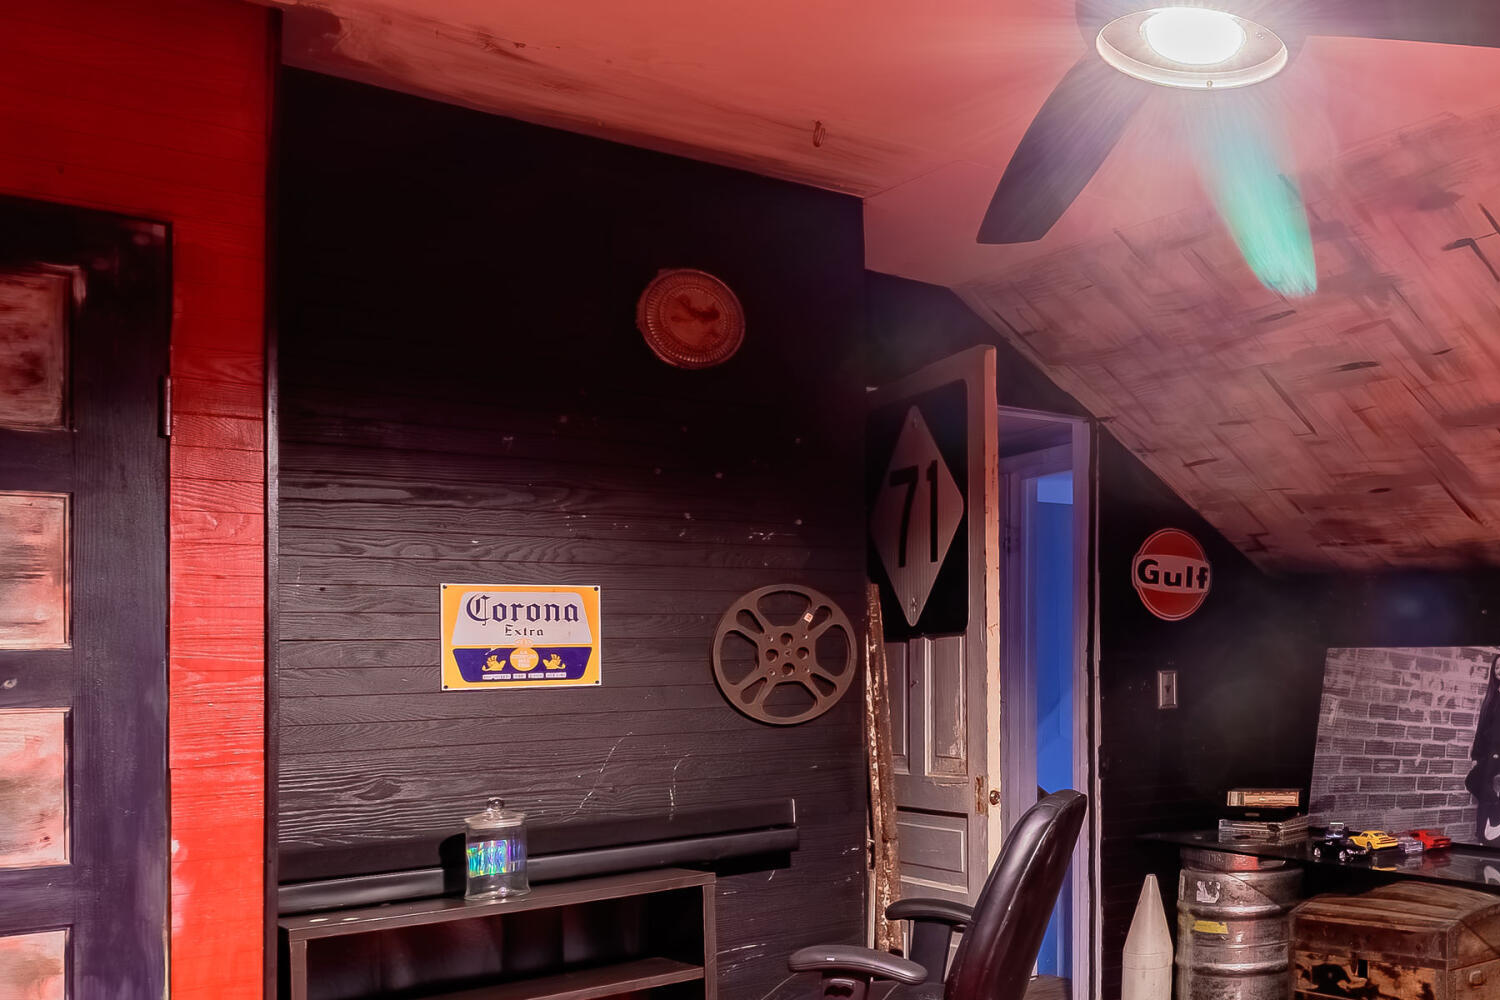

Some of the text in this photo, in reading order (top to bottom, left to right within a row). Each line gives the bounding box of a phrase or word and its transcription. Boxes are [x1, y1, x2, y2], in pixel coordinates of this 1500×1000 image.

[890, 459, 939, 568] 71
[1137, 559, 1209, 588] Gulf
[466, 593, 580, 626] Corona
[504, 623, 544, 637] Extra
